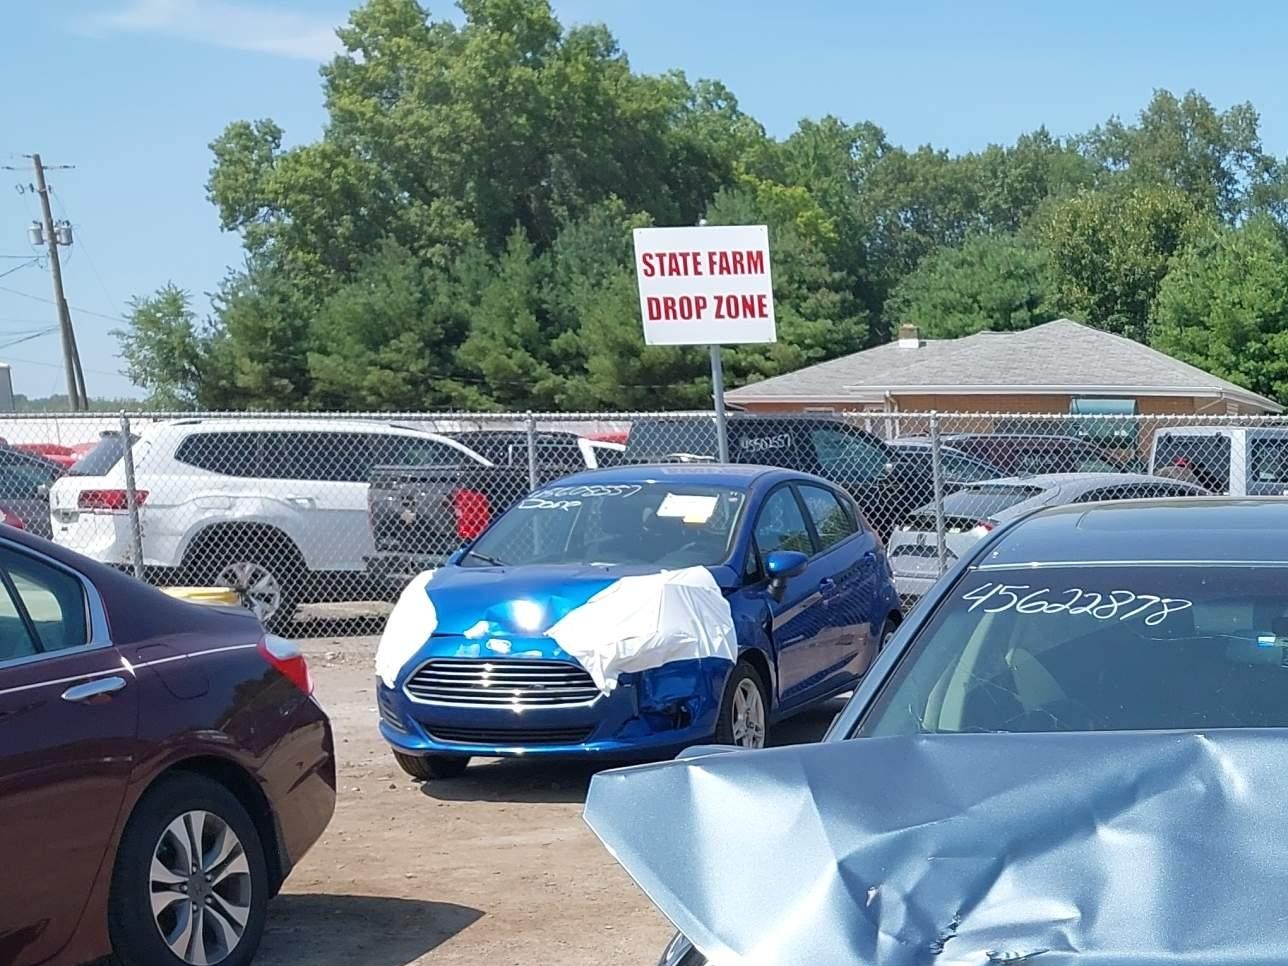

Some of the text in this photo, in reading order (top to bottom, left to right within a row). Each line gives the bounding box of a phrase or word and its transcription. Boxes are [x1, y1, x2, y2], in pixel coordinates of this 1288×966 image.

[641, 250, 765, 278] STATE FARM
[647, 294, 769, 321] DROP ZONE
[962, 582, 1193, 626] 45622878
